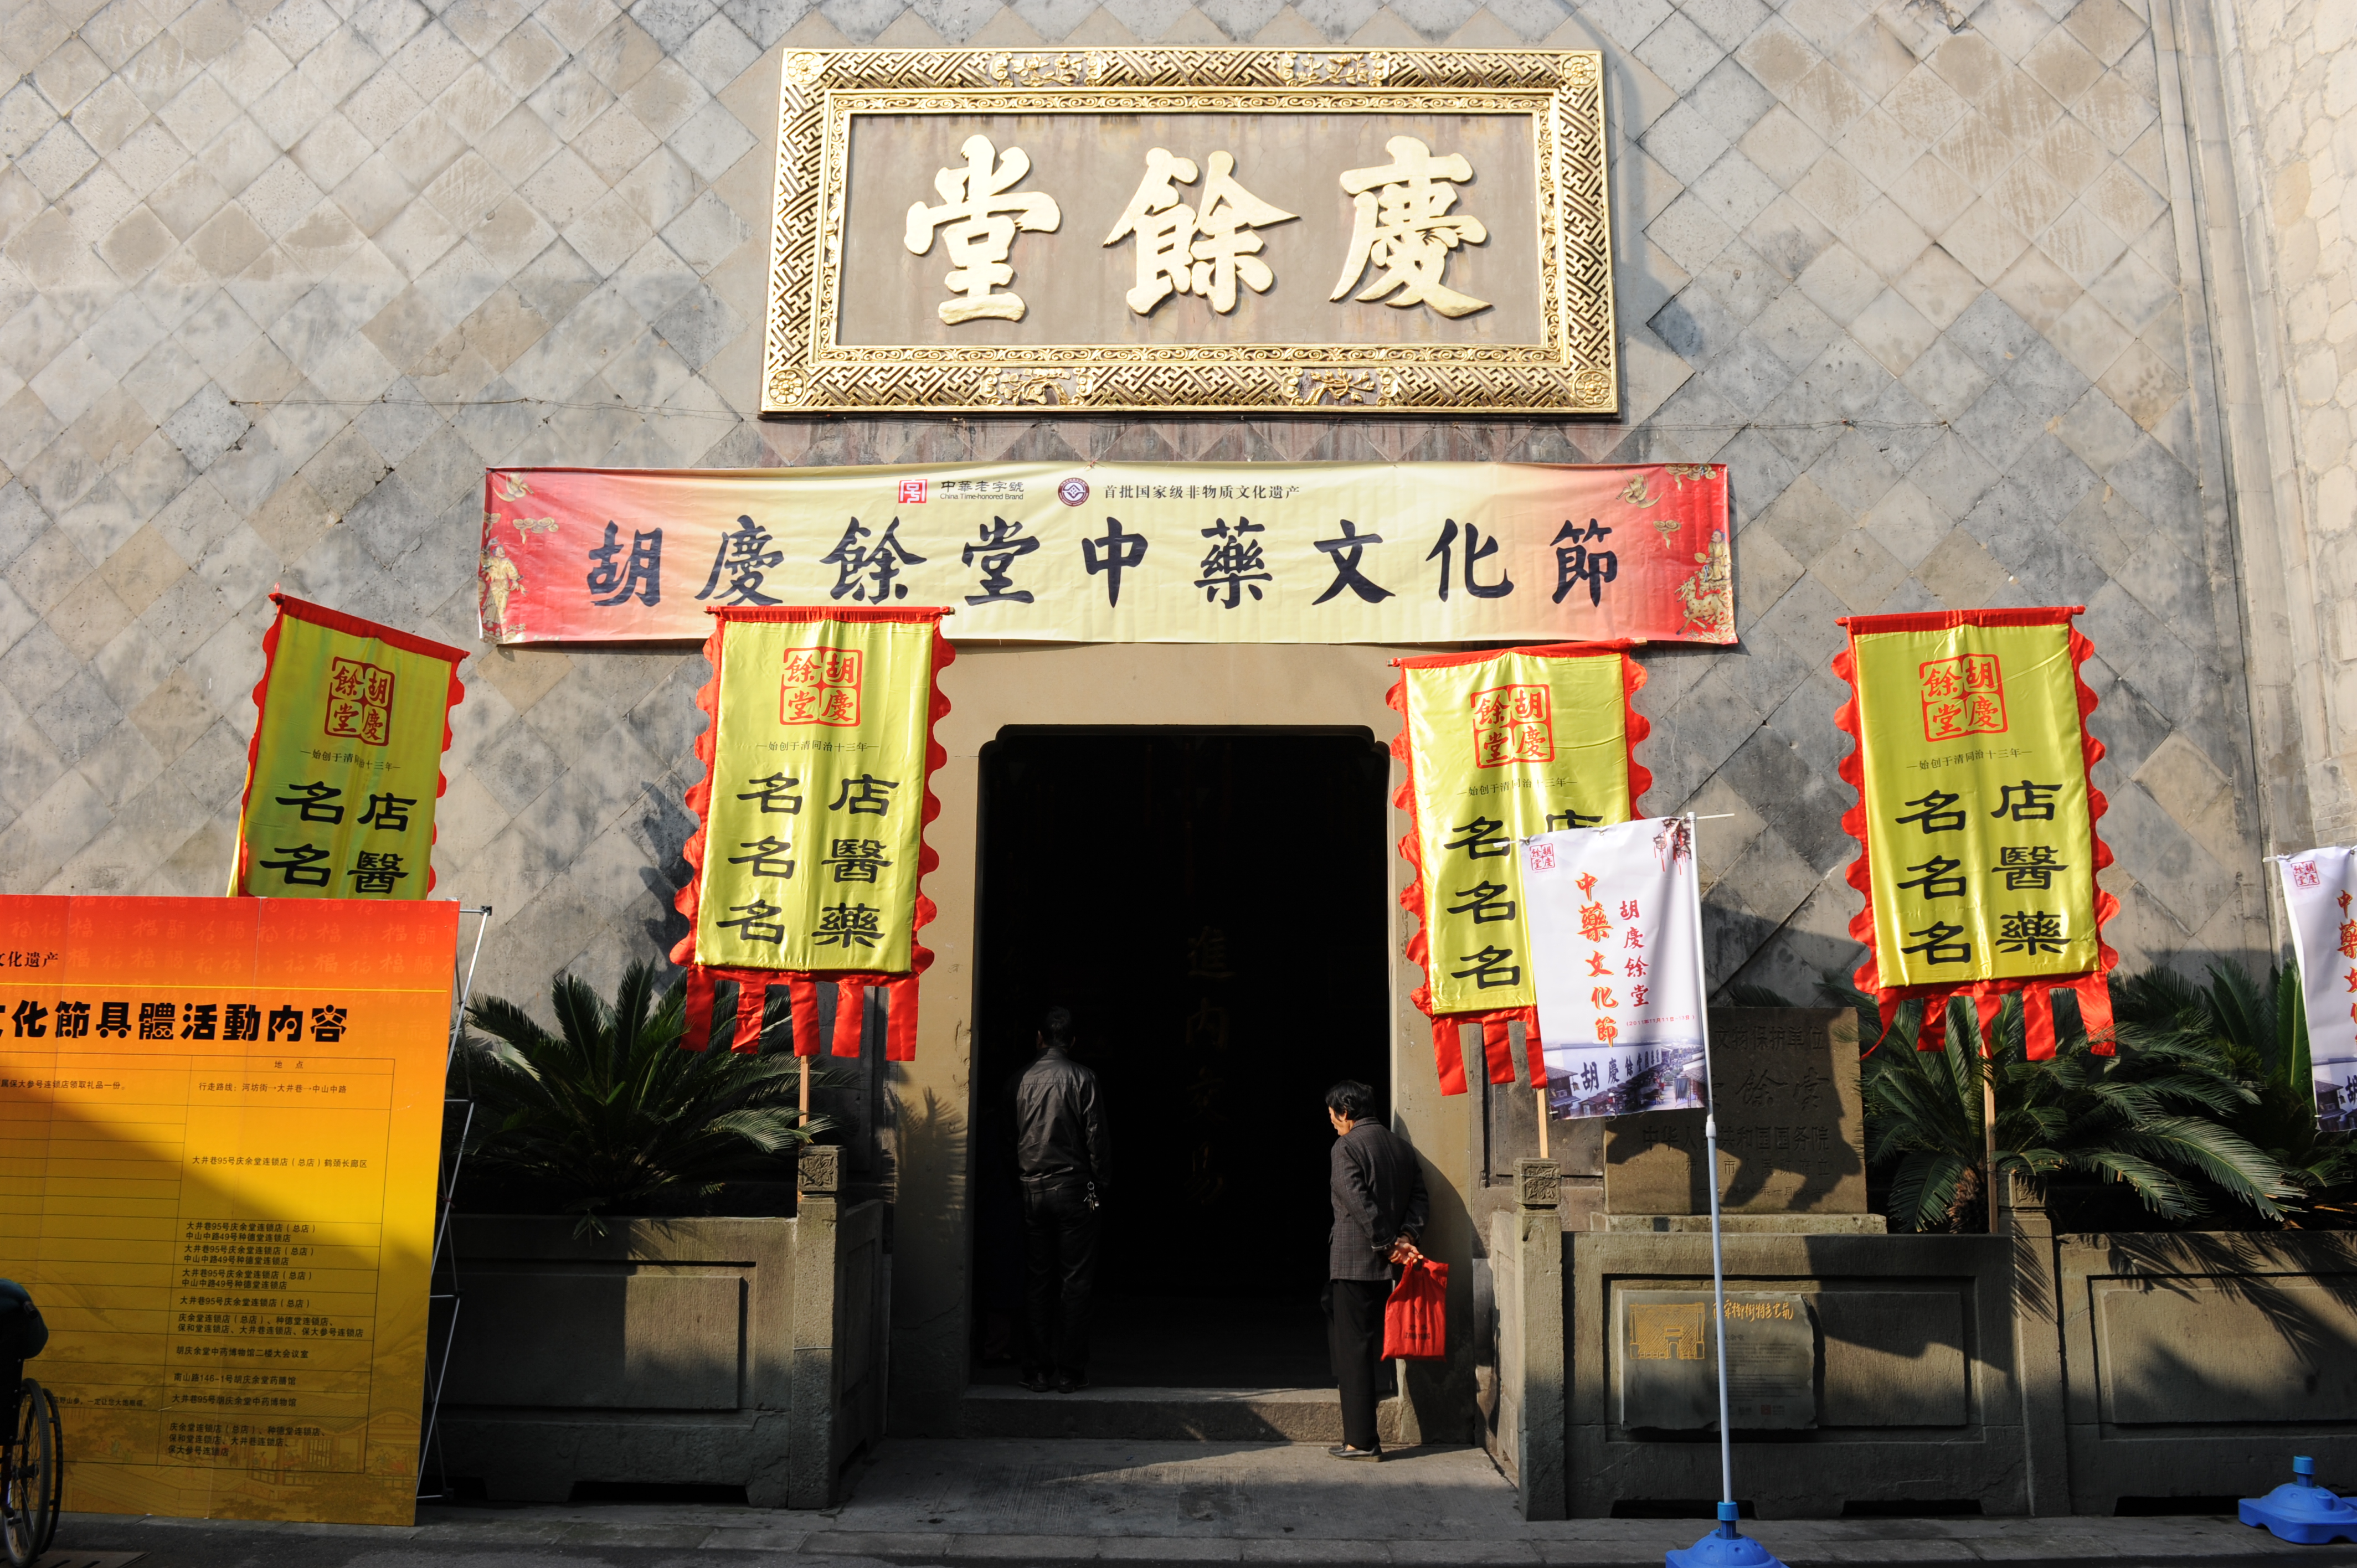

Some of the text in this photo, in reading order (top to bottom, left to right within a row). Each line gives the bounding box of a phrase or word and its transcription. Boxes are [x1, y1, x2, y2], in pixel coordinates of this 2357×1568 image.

[941, 481, 1024, 492] 中華老字號
[1103, 485, 1300, 499] 首批国家级非物质文化遗产
[586, 514, 1618, 609] 胡慶餘堂中藥文化節
[1620, 899, 1649, 1007] 胡慶餘堂
[1575, 872, 1618, 1047] 中藥文化節
[0, 999, 347, 1042] 化節具體活動内容
[1708, 1026, 1824, 1050] 文物保护单位
[187, 1221, 316, 1233] 大井巷95号庆余堂连锁店（总店）
[186, 1232, 291, 1242] 中山中路49号种德堂连锁店
[184, 1245, 313, 1256] 大井巷95号庆余堂连锁店（总店）
[184, 1255, 289, 1266] 中山中路49号种德堂连锁店
[182, 1268, 312, 1280] 大井巷95号庆余堂连锁店（总店）
[182, 1279, 287, 1290] 中山中路49号种德堂连锁店
[180, 1296, 310, 1308] 大井巷95号庆余堂连锁店（总店）
[176, 1345, 309, 1359] 胡庆余堂中药博物馆二楼大会议室
[172, 1394, 297, 1407] 大井巷95号胡庆余堂中药博物馆
